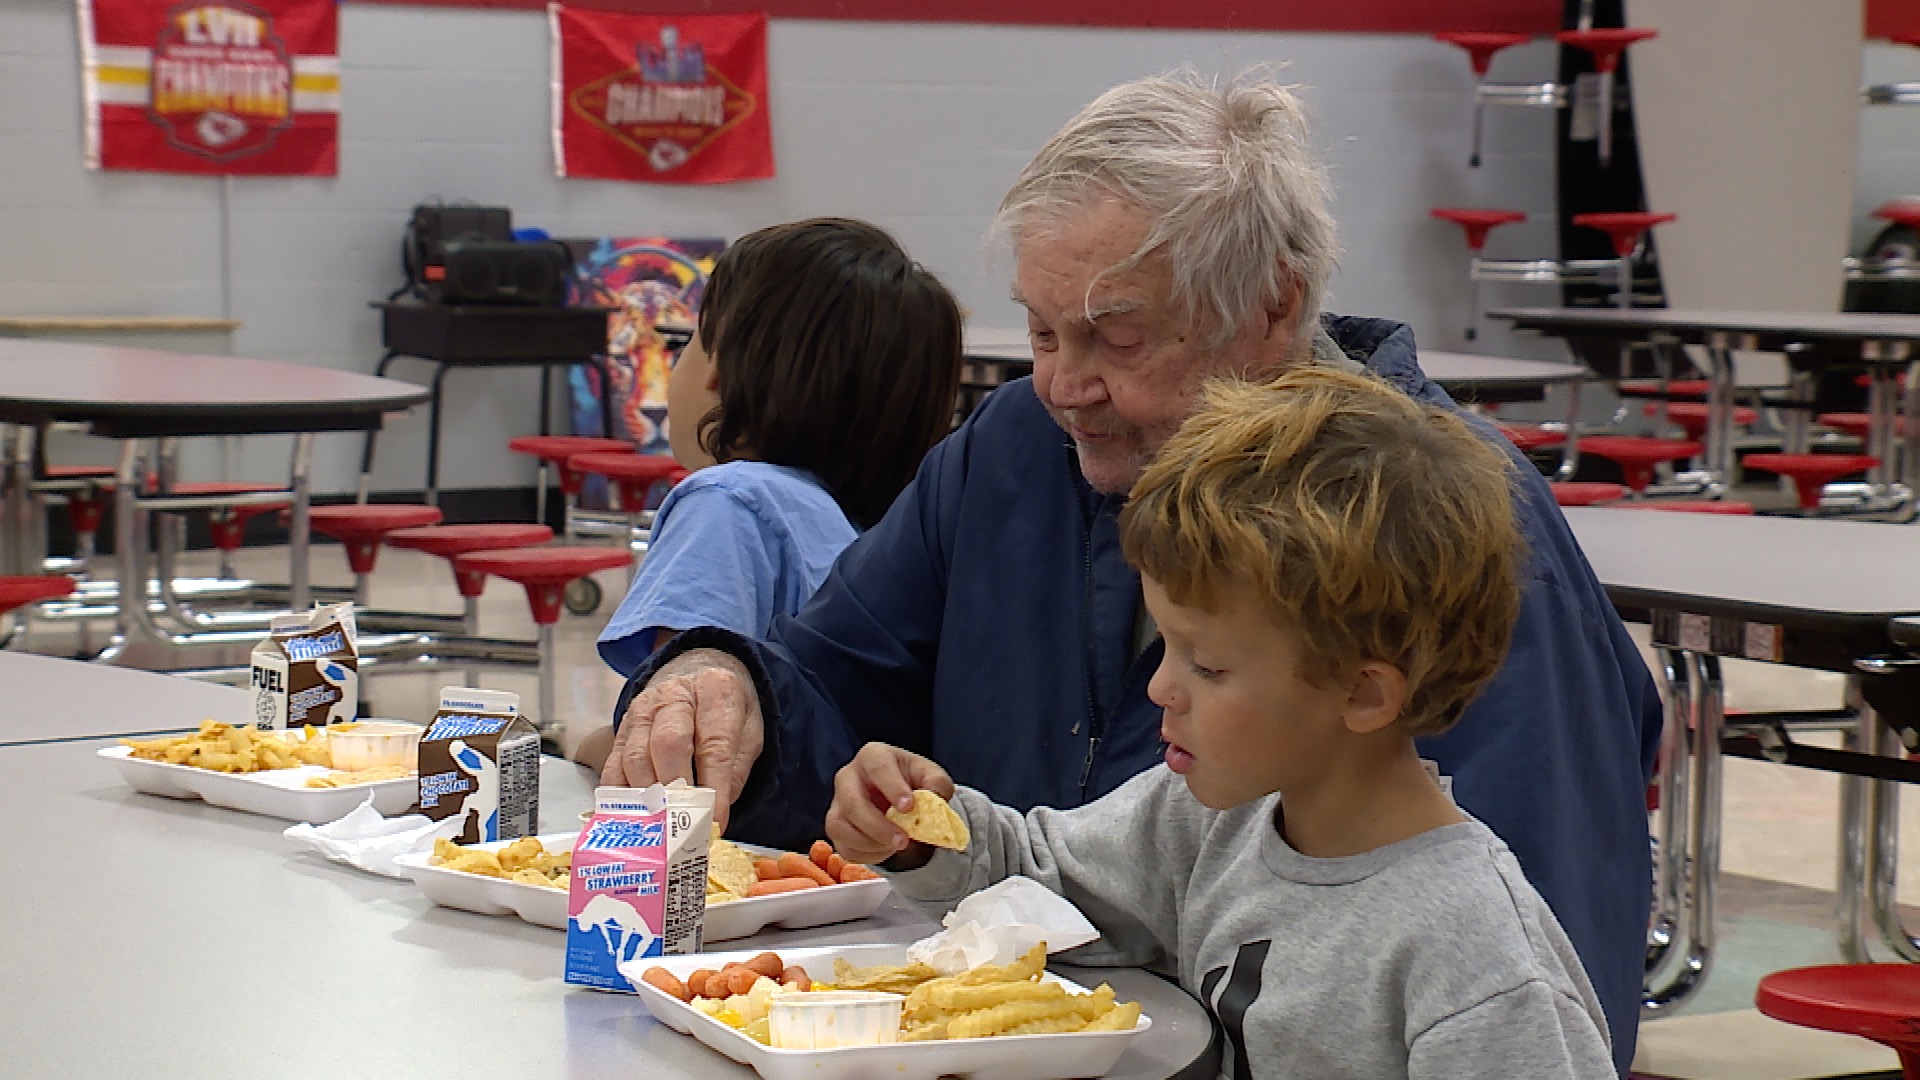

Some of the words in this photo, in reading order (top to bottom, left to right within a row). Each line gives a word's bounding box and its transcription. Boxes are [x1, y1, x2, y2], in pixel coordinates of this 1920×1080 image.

[253, 666, 284, 692] FUEL
[422, 779, 469, 797] CHOCOLATE
[587, 872, 655, 890] STRAWBERRY
[640, 885, 660, 895] MILK
